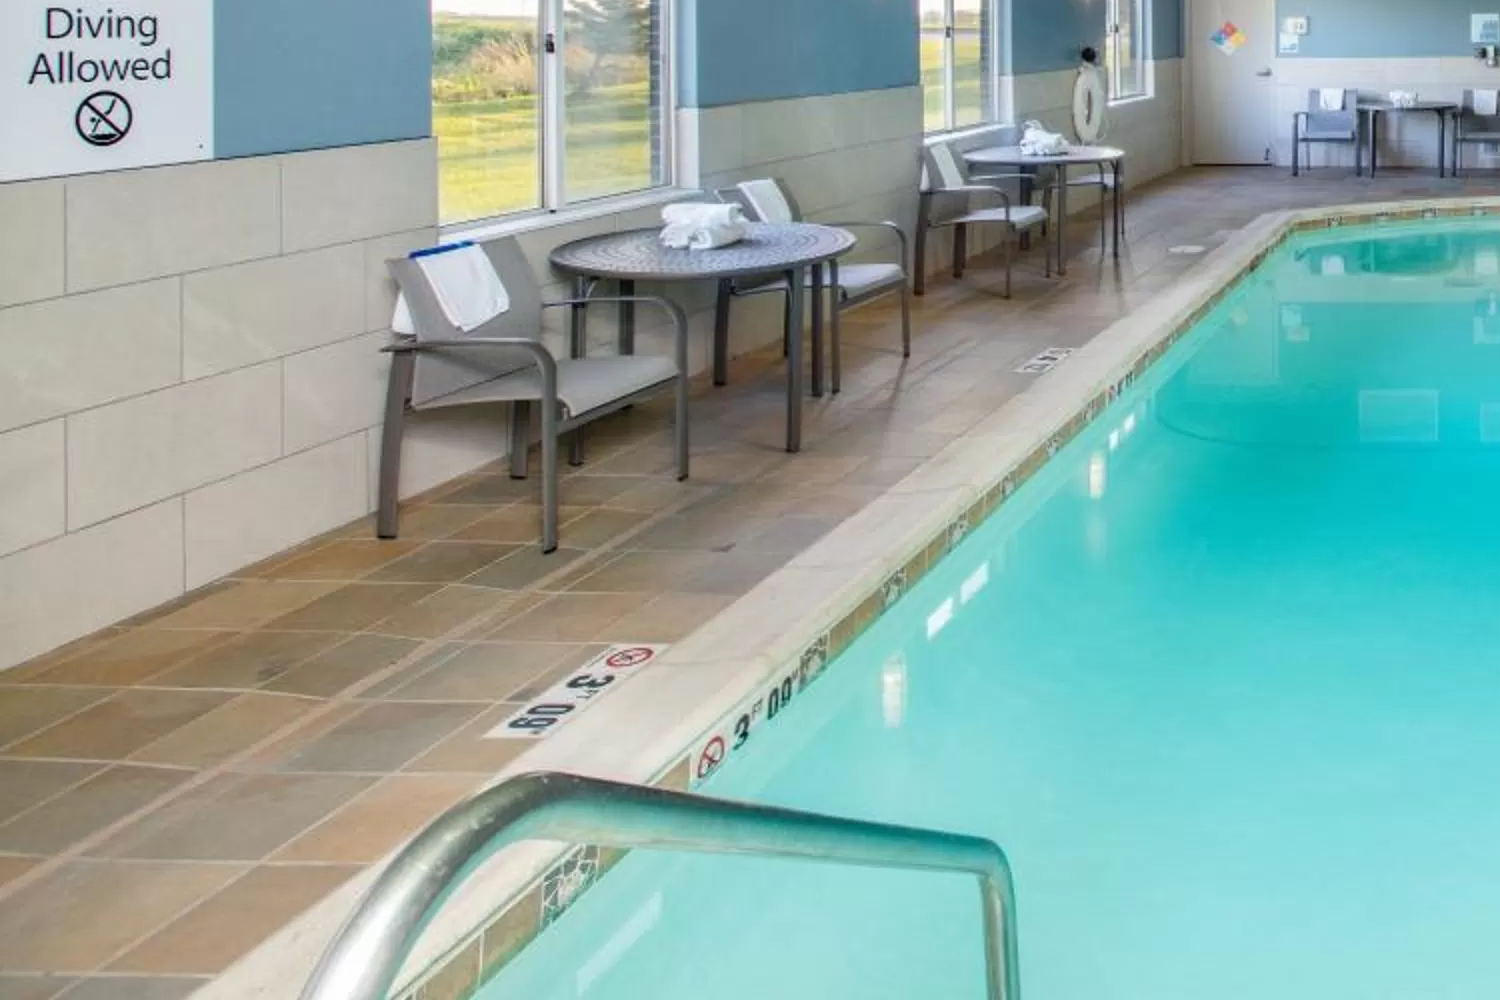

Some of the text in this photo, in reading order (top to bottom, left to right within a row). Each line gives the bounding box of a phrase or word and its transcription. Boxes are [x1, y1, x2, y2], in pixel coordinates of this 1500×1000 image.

[46, 7, 157, 46] Diving
[28, 48, 171, 84] Allowed
[733, 713, 750, 751] 3
